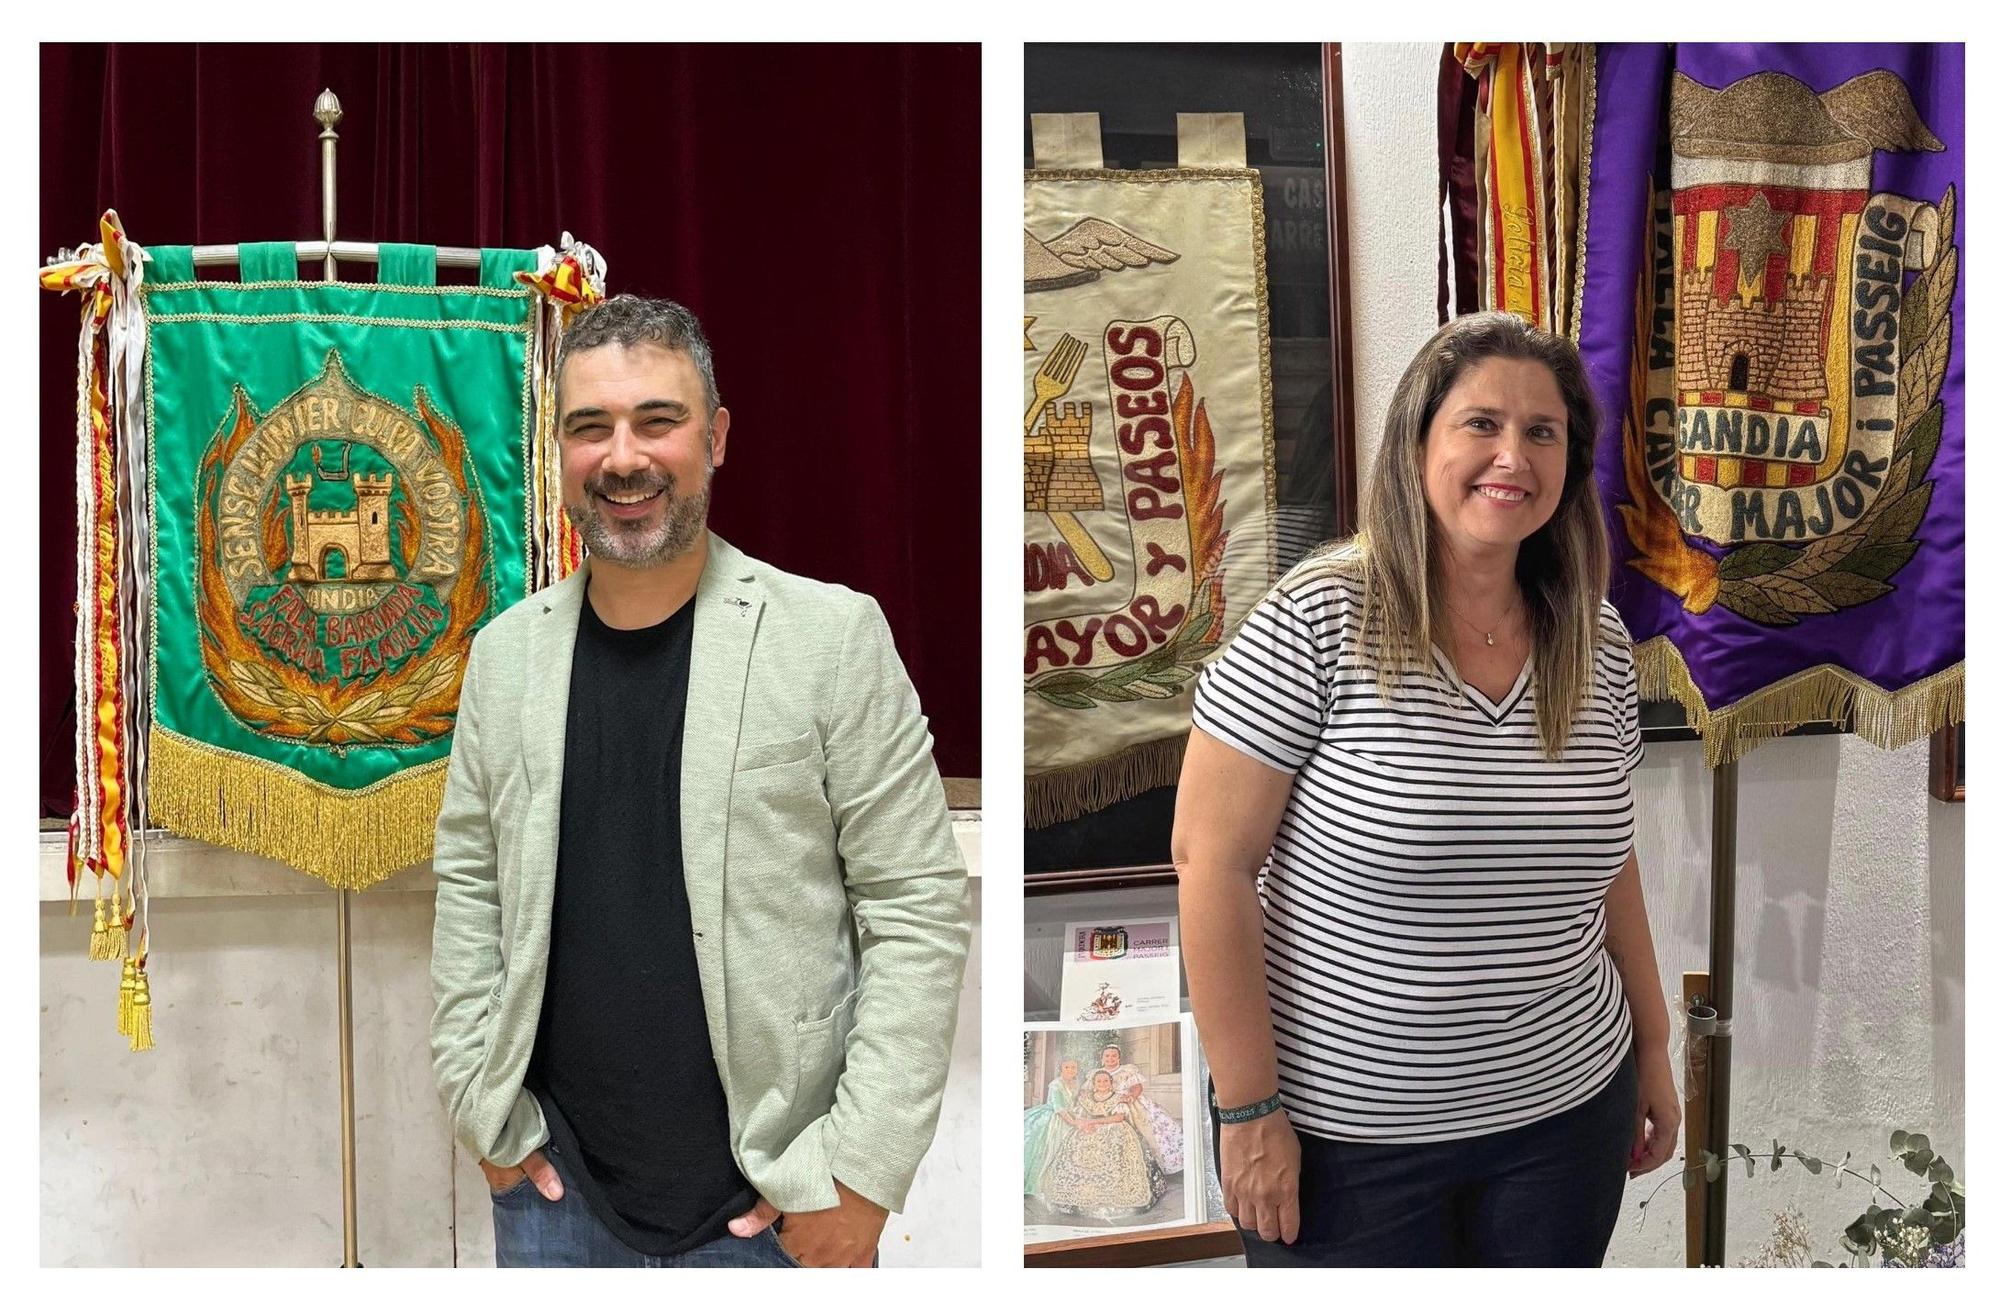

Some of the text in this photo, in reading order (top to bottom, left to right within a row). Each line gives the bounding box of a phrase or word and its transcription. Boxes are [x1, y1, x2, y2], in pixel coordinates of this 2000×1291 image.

[1107, 327, 1184, 520] PASEOS
[1730, 450, 1888, 540] MAJOR
[1854, 205, 1907, 397] PASSEIG
[220, 475, 262, 577] SENSE
[294, 396, 342, 437] PER
[352, 404, 421, 460] CULPA
[416, 458, 460, 574] VOSTRA
[1146, 542, 1186, 576] Y
